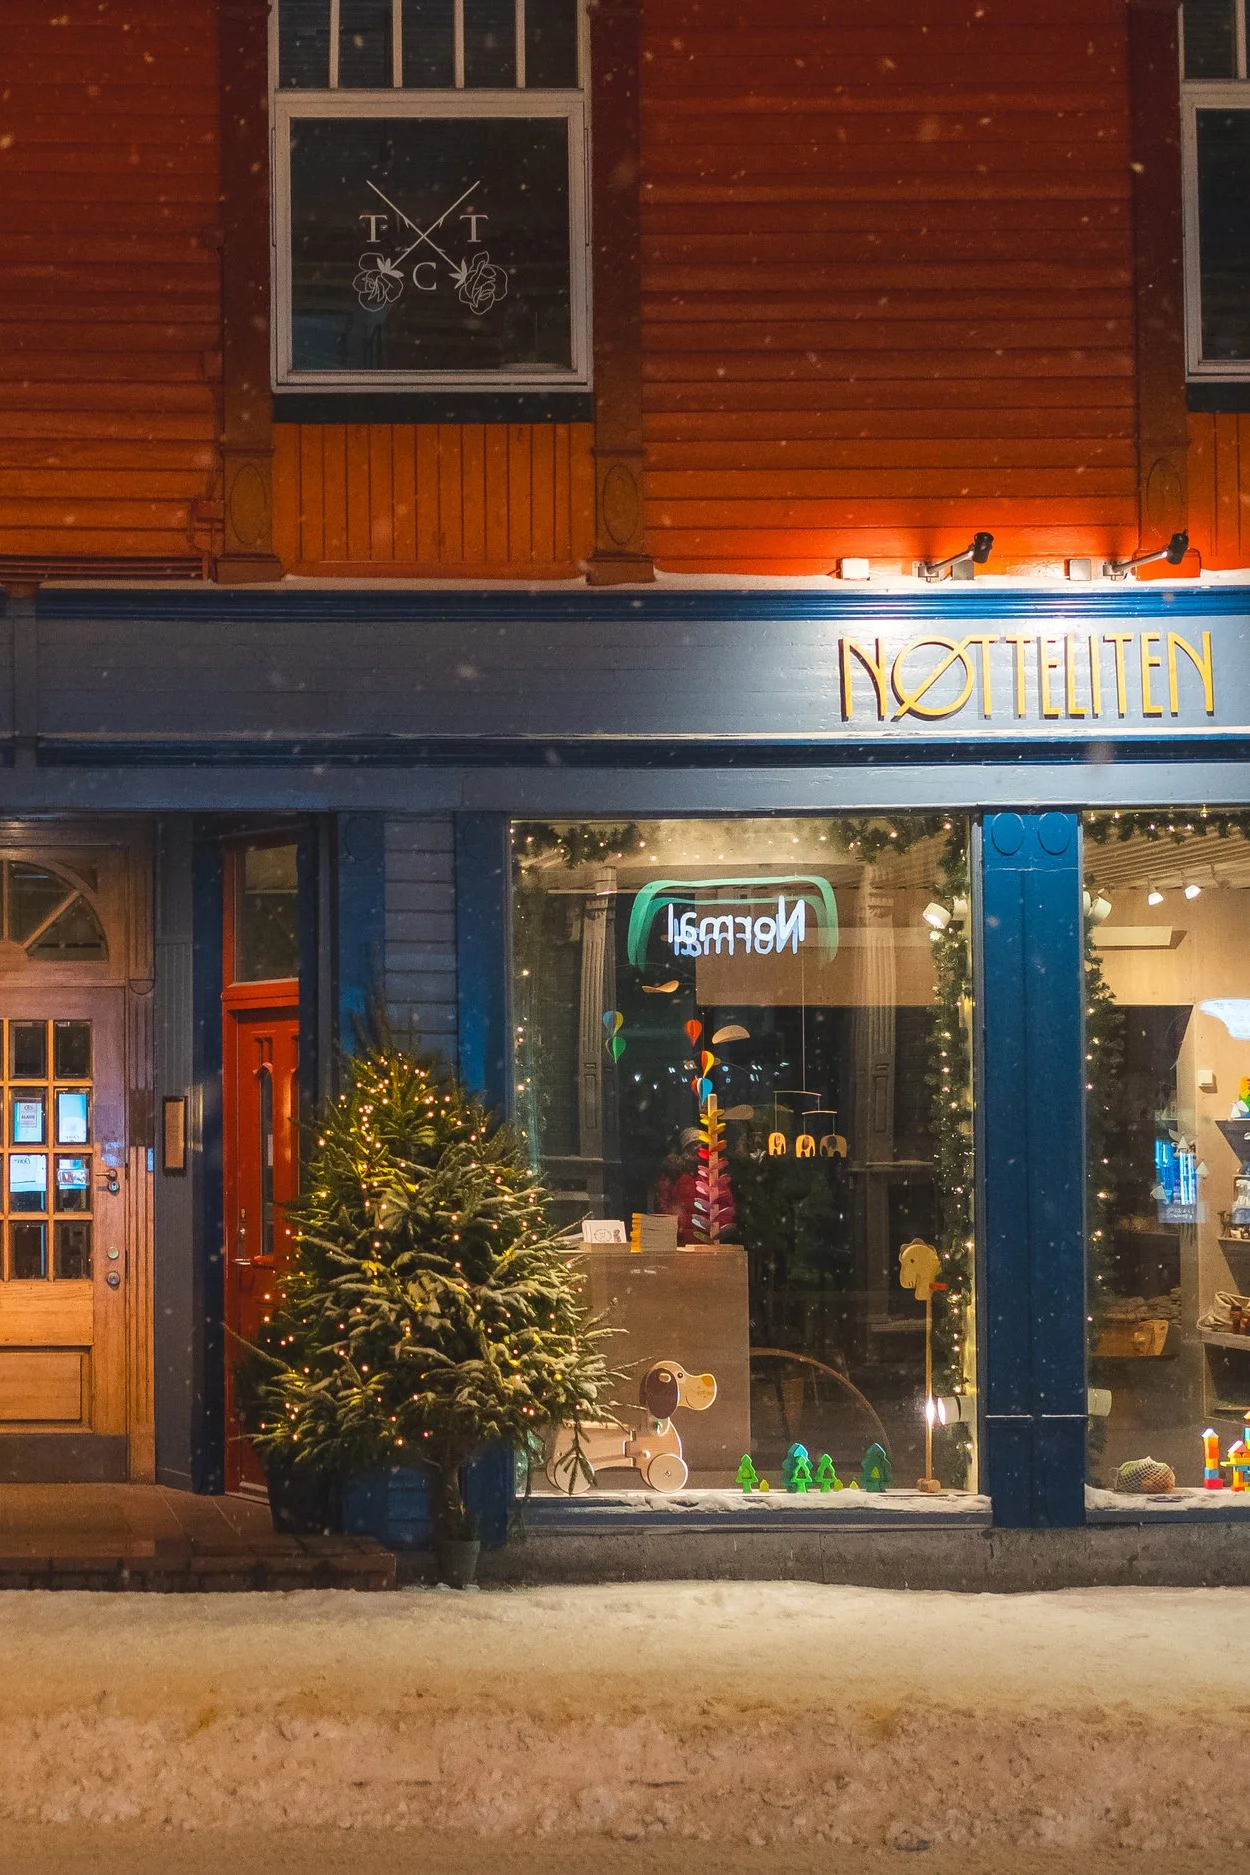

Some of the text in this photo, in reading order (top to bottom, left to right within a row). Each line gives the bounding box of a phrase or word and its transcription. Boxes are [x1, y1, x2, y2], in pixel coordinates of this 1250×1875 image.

[358, 214, 489, 243] T T
[412, 261, 437, 291] C
[838, 631, 1215, 722] NØTTELITEN
